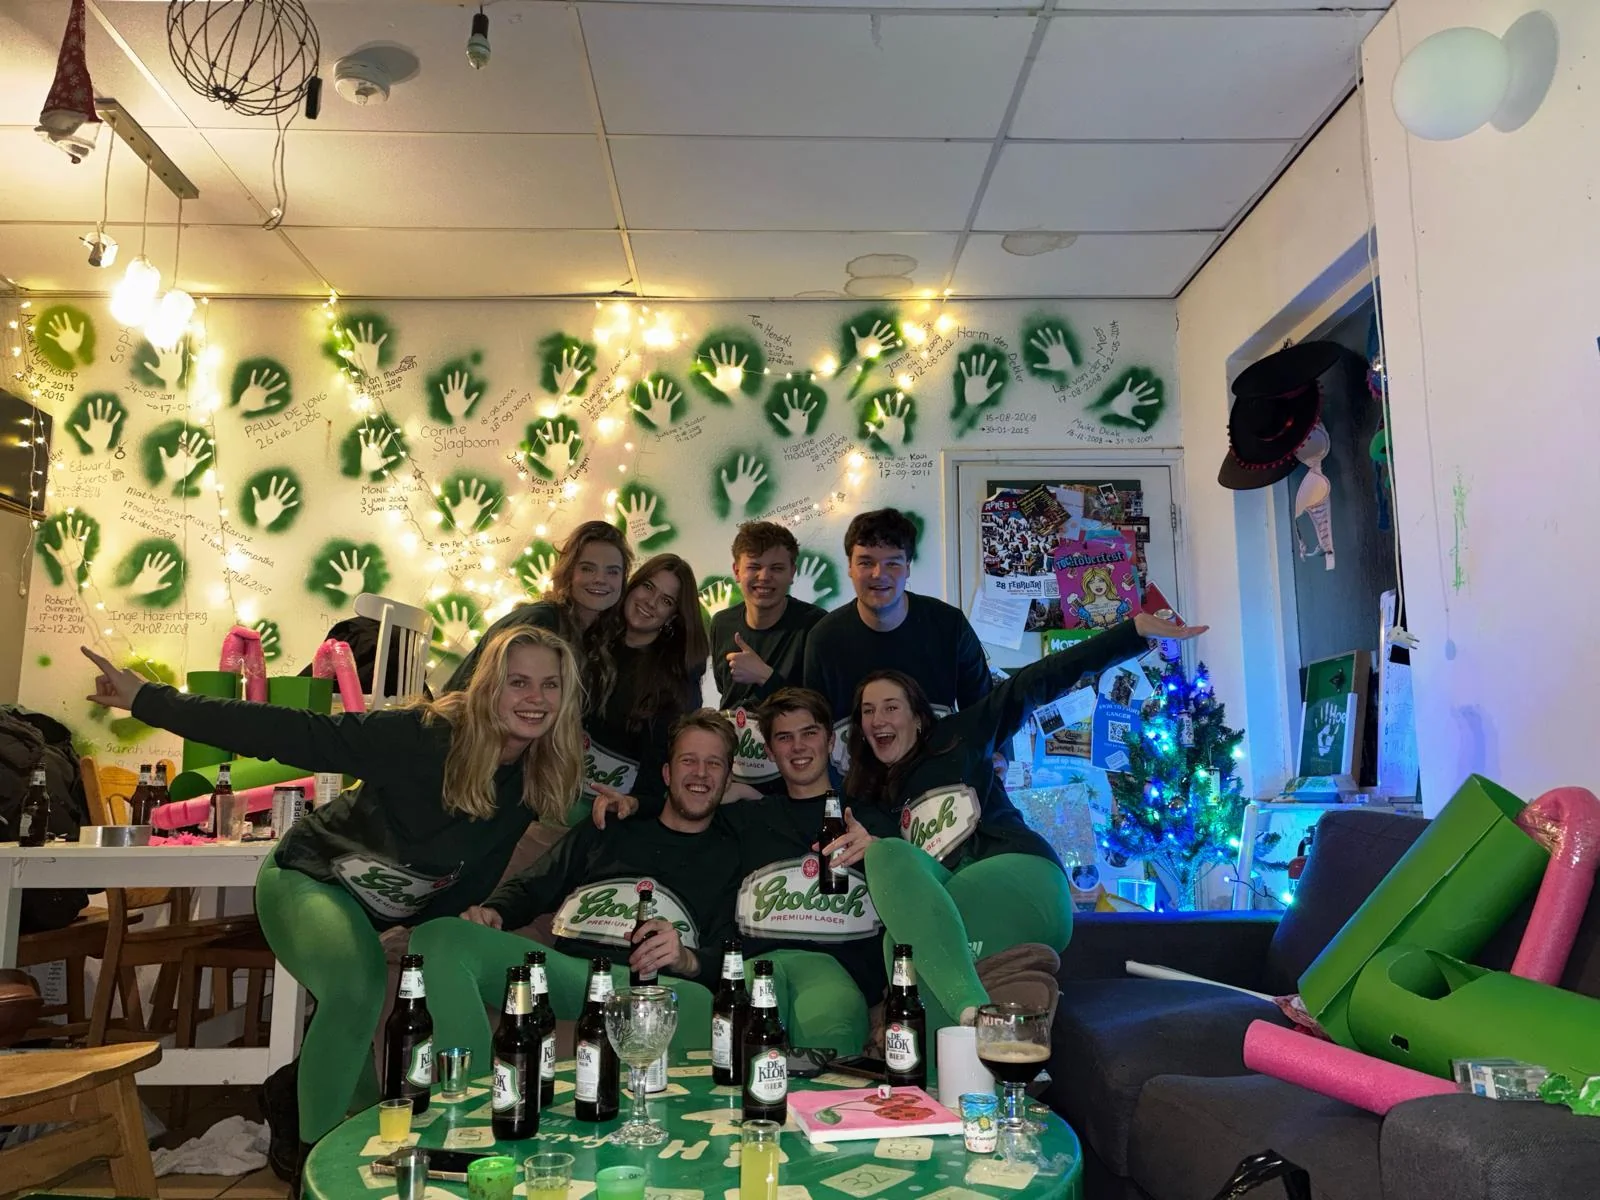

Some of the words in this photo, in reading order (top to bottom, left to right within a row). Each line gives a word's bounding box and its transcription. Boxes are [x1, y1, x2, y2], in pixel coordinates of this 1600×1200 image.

[957, 325, 990, 341] Harm
[993, 334, 1010, 350] den
[244, 418, 280, 438] PAUL
[284, 405, 302, 422] DE
[303, 391, 328, 417] JONG
[420, 425, 467, 438] Corine
[256, 434, 274, 449] 26
[432, 436, 500, 458] Slagboom
[69, 459, 111, 472] Edward
[531, 476, 548, 486] van
[996, 581, 1006, 589] 28
[45, 594, 74, 606] Robert
[110, 610, 138, 625] Inge
[752, 875, 869, 922] Grolsch
[586, 918, 629, 930] PREMIUM
[770, 914, 813, 922] PREMIUM
[815, 915, 845, 925] LAGER
[887, 1036, 911, 1054] KLOK
[767, 1060, 779, 1069] DE
[758, 1064, 787, 1083] KLOK
[763, 1081, 783, 1090] BIER
